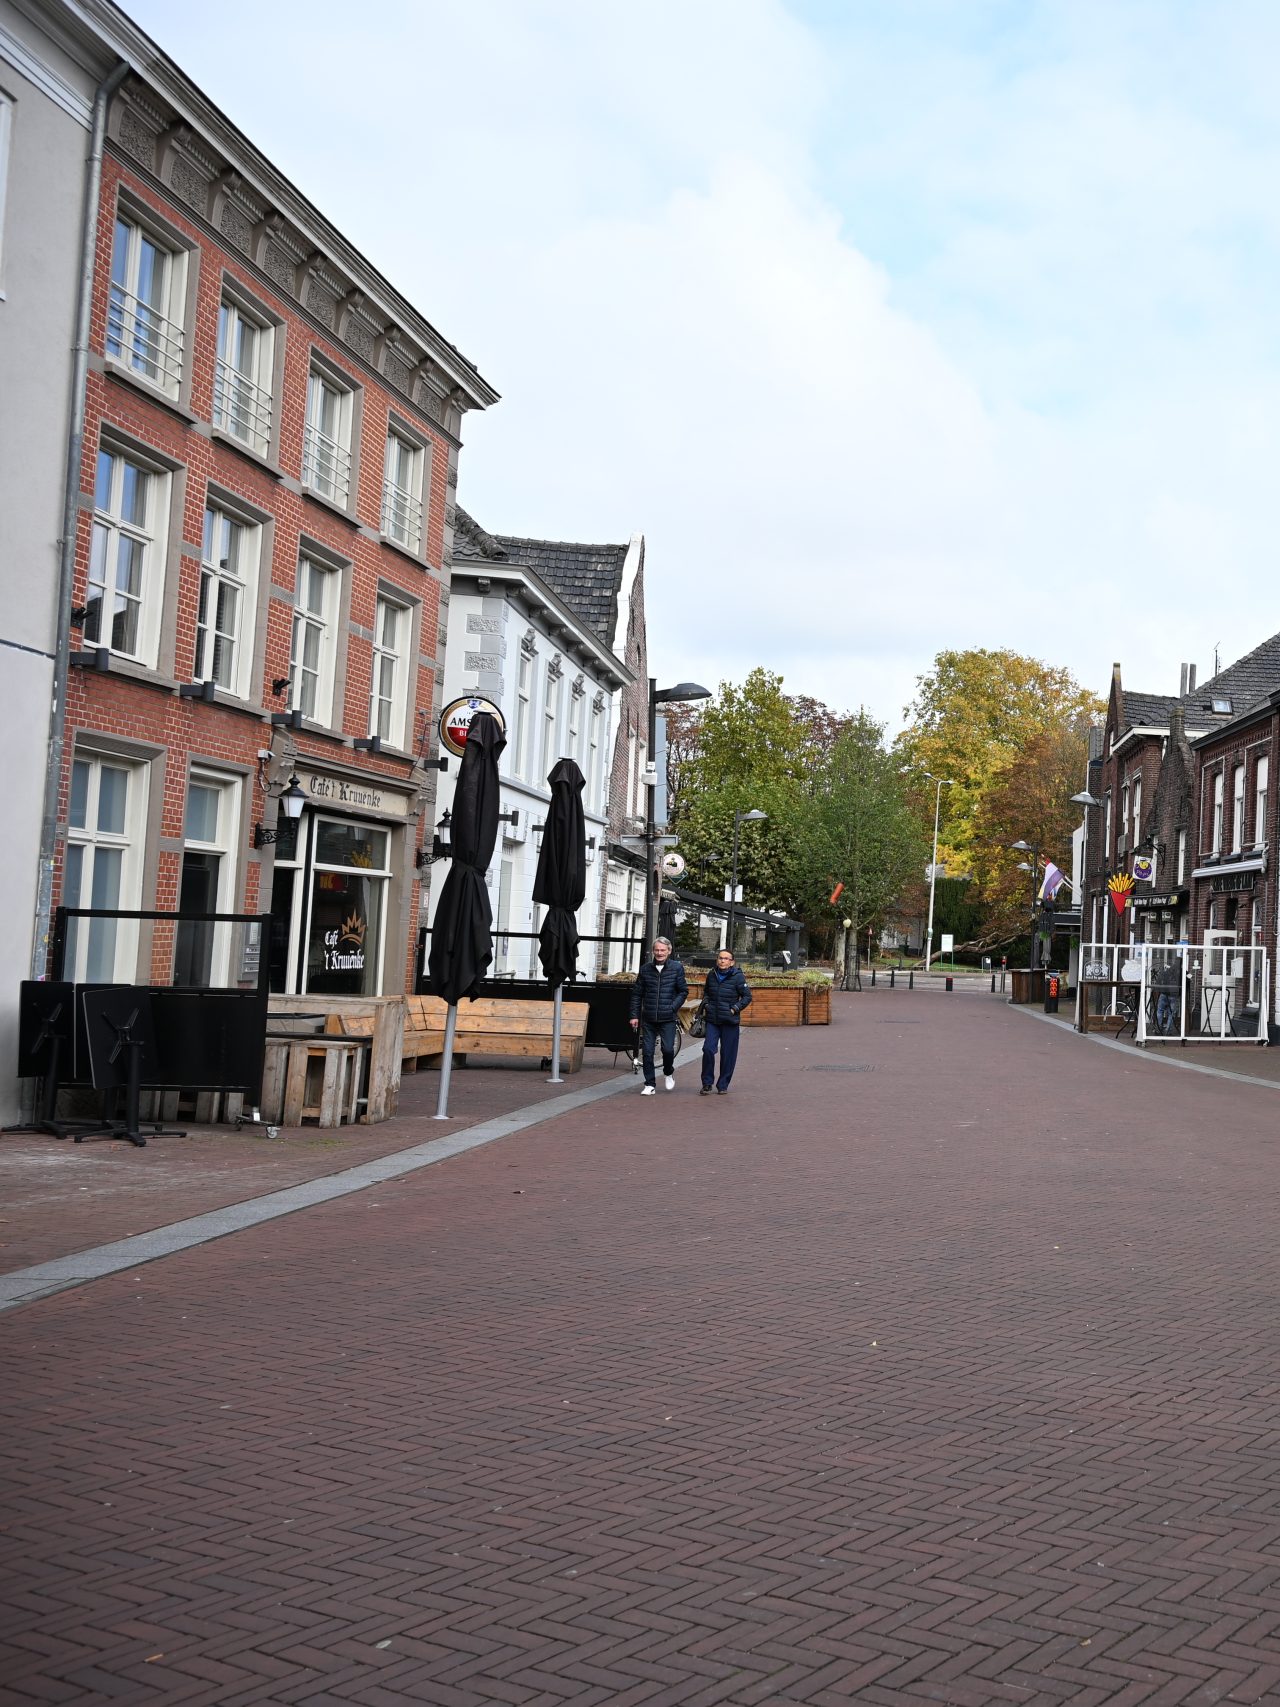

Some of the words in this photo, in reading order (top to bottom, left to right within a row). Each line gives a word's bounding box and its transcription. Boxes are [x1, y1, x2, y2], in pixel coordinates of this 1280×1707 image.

[450, 717, 472, 727] AMS
[310, 775, 330, 797] Café
[324, 929, 339, 949] Café
[323, 950, 330, 970] 't
